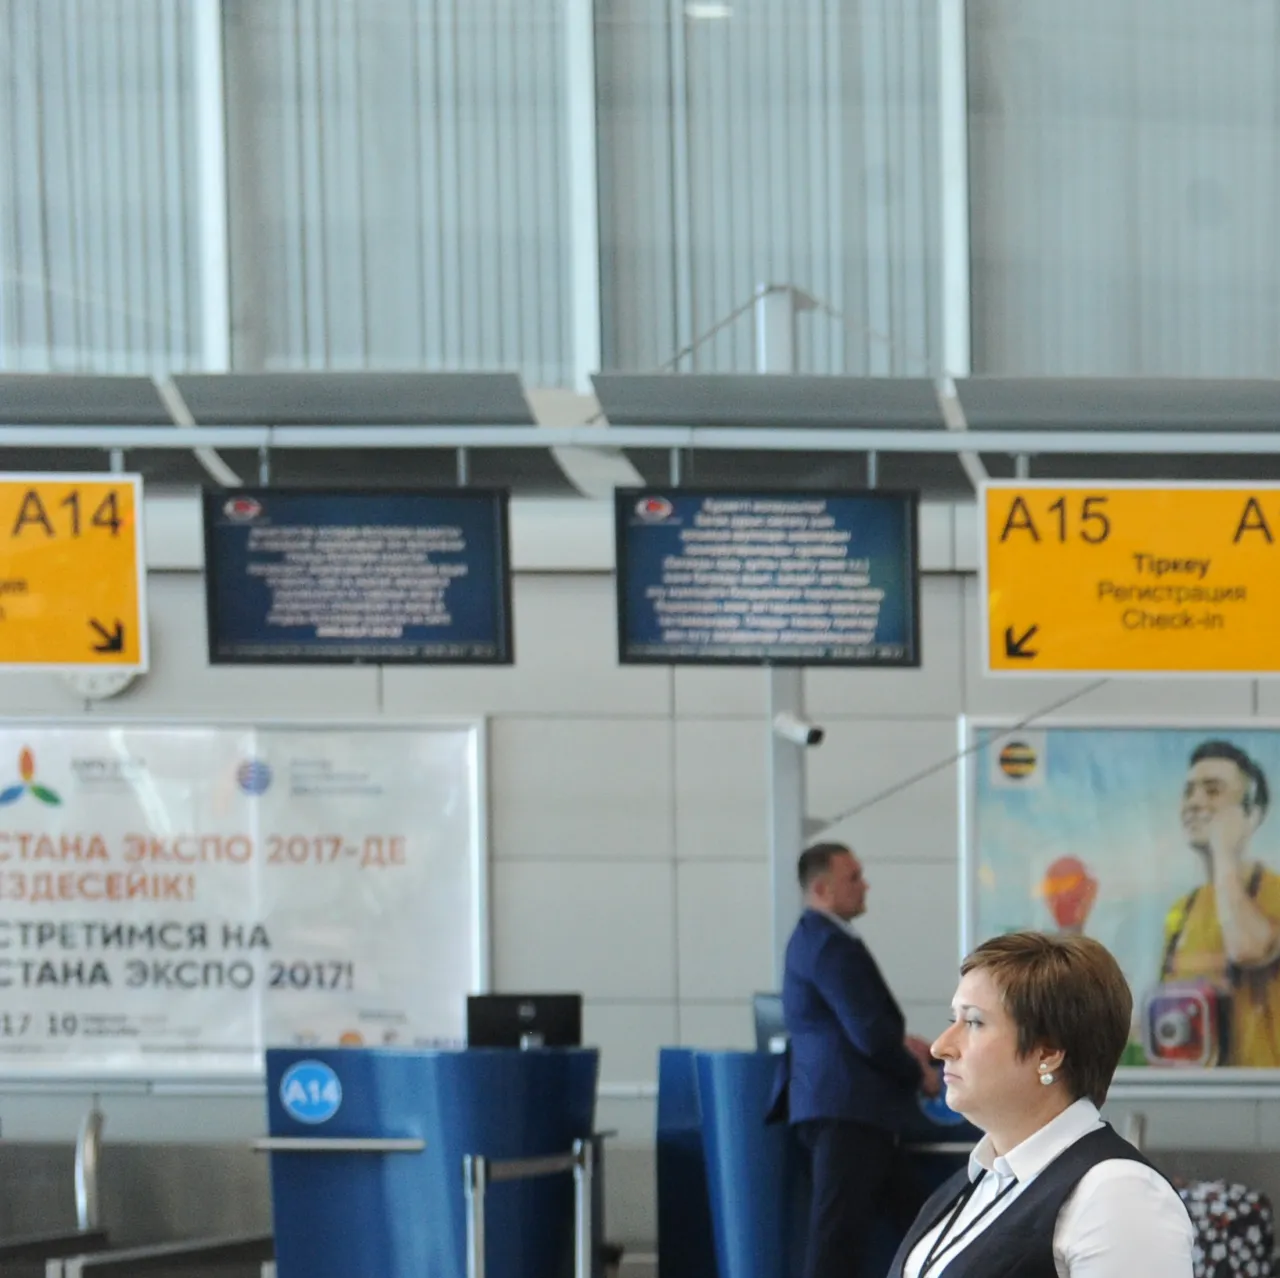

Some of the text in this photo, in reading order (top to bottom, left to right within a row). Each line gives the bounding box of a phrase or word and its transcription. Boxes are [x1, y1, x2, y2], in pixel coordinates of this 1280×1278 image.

[11, 489, 121, 538] A14
[1000, 496, 1111, 545] A15
[1132, 553, 1211, 578] Тіркеу
[1097, 581, 1248, 604] Регистрация
[1122, 608, 1224, 631] Check-in
[123, 832, 254, 864] ЭКСПО
[266, 833, 407, 869] 2017-ДЕ
[221, 922, 273, 950] НА
[125, 959, 254, 990] ЭКСПО
[268, 959, 355, 991] 2017!
